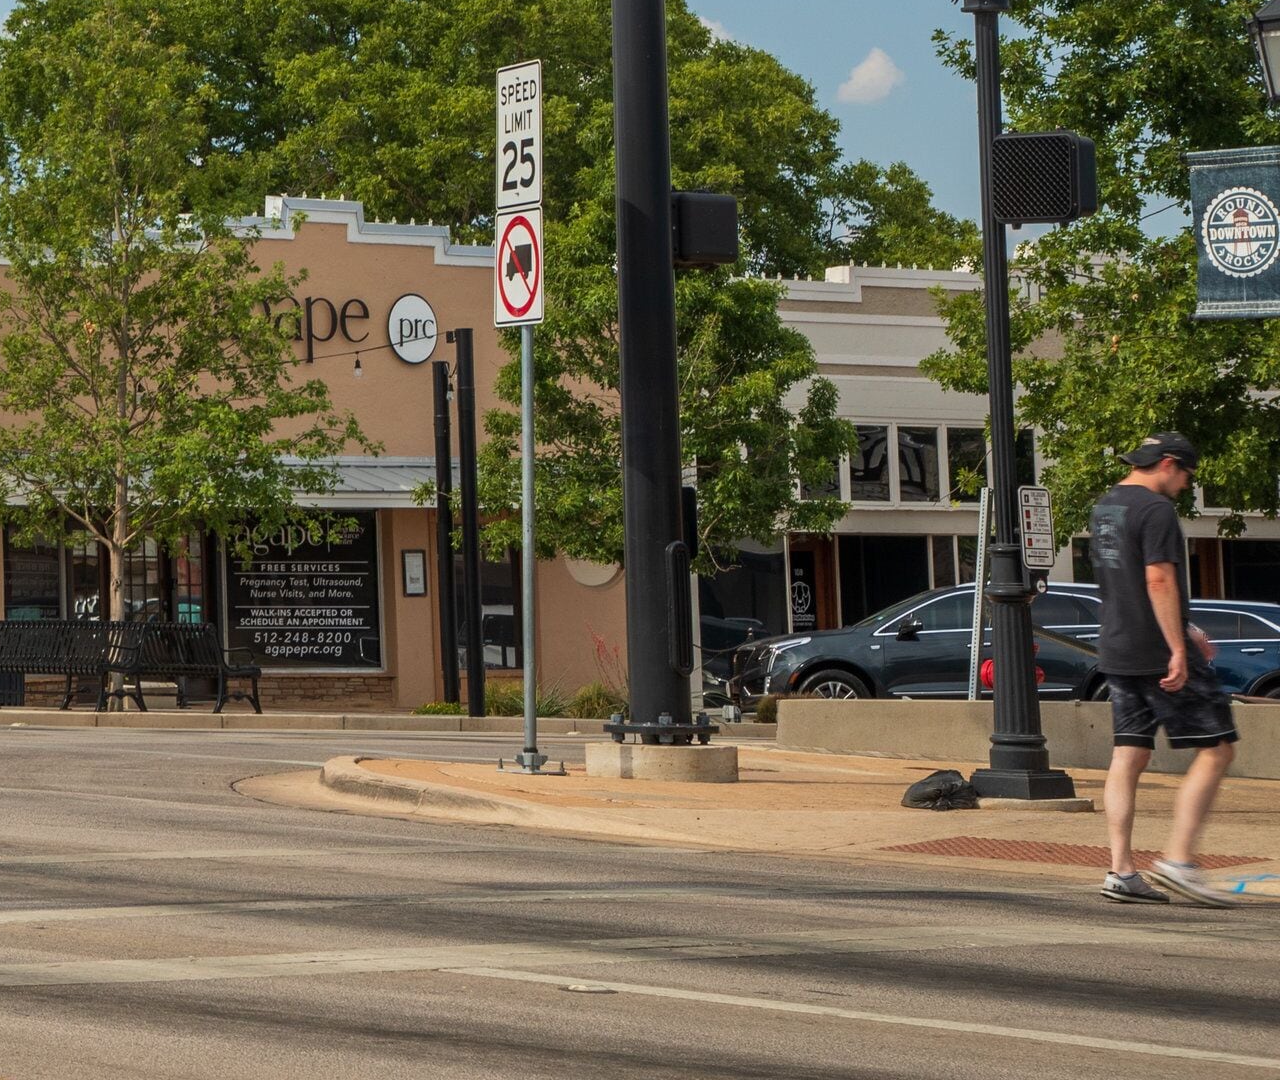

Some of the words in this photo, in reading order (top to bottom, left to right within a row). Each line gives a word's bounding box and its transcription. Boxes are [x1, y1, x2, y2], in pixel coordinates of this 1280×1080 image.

[500, 80, 537, 106] SPEED
[504, 109, 533, 134] LIMIT
[502, 137, 536, 192] 25
[1216, 198, 1266, 220] ROUND
[1208, 224, 1276, 241] DOWNTOWN
[1224, 251, 1262, 267] ROCK
[399, 317, 435, 347] prc
[260, 563, 286, 572] FREE
[291, 563, 341, 572] SERVICES
[240, 577, 287, 588] Pregnancy
[289, 577, 310, 587] Test,
[312, 577, 364, 587] Ultrasound,
[250, 589, 277, 598] Nurse
[279, 589, 306, 599] Visits,
[308, 589, 325, 598] and
[327, 589, 354, 598] More.
[250, 609, 292, 617] WALK-INS
[294, 609, 338, 617] ACCEPTED
[340, 609, 353, 617] OR
[240, 618, 284, 626] SCHEDULE
[286, 618, 300, 626] AN
[302, 618, 364, 626] APPOINTMENT
[254, 632, 352, 643] 512-248-8200
[265, 645, 343, 657] agapeprc.org
